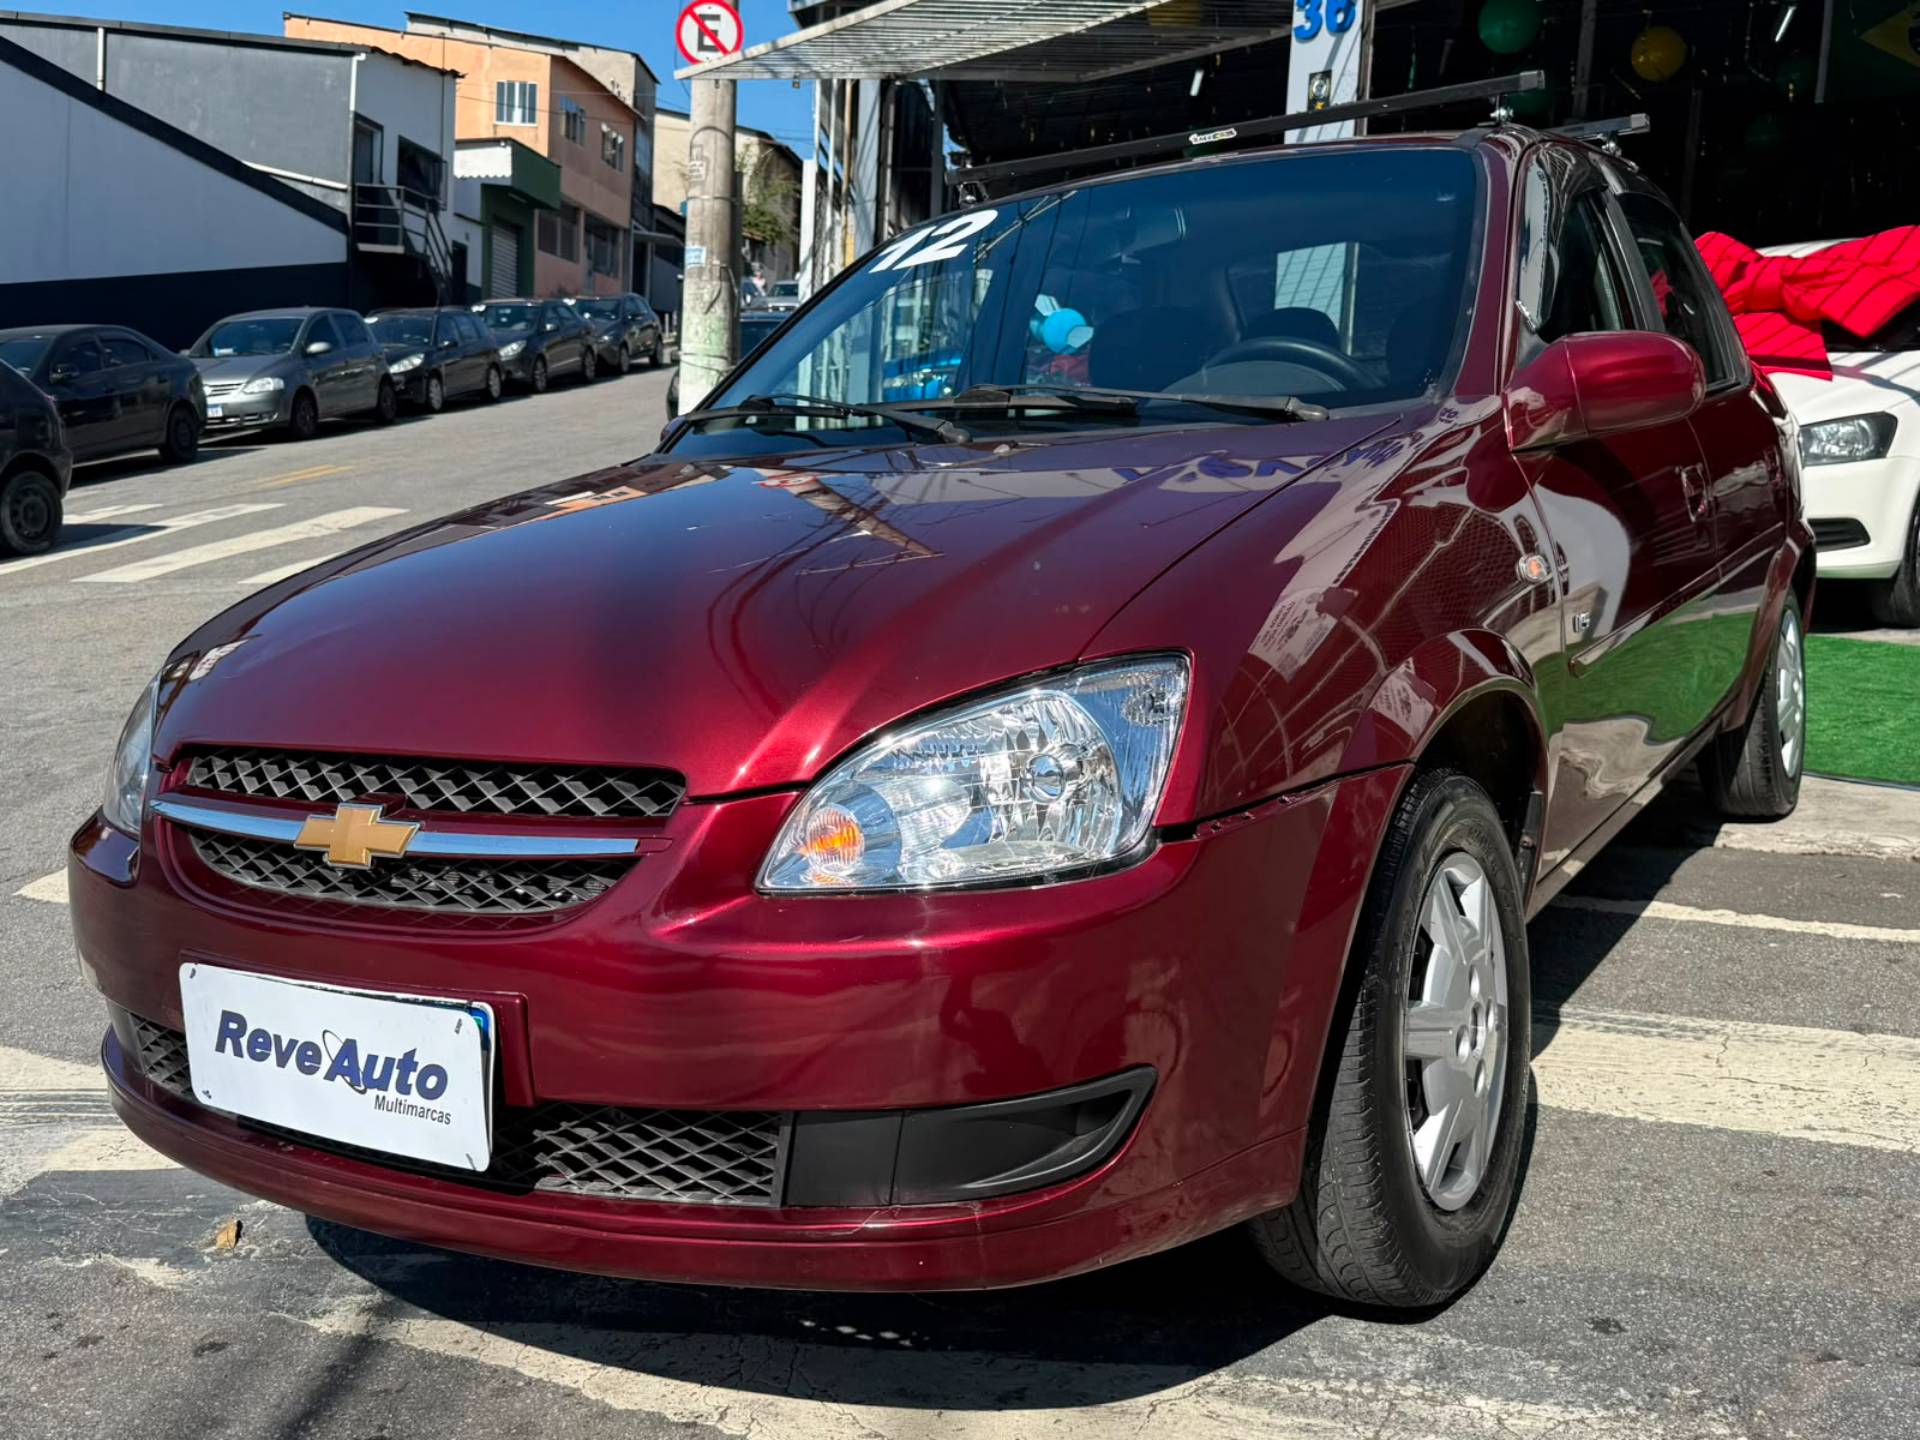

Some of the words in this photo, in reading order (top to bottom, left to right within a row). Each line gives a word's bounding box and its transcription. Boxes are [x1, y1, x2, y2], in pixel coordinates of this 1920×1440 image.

[697, 14, 721, 52] E
[1294, 0, 1356, 40] 36
[868, 209, 998, 273] 12
[374, 1094, 452, 1125] Multimarcas
